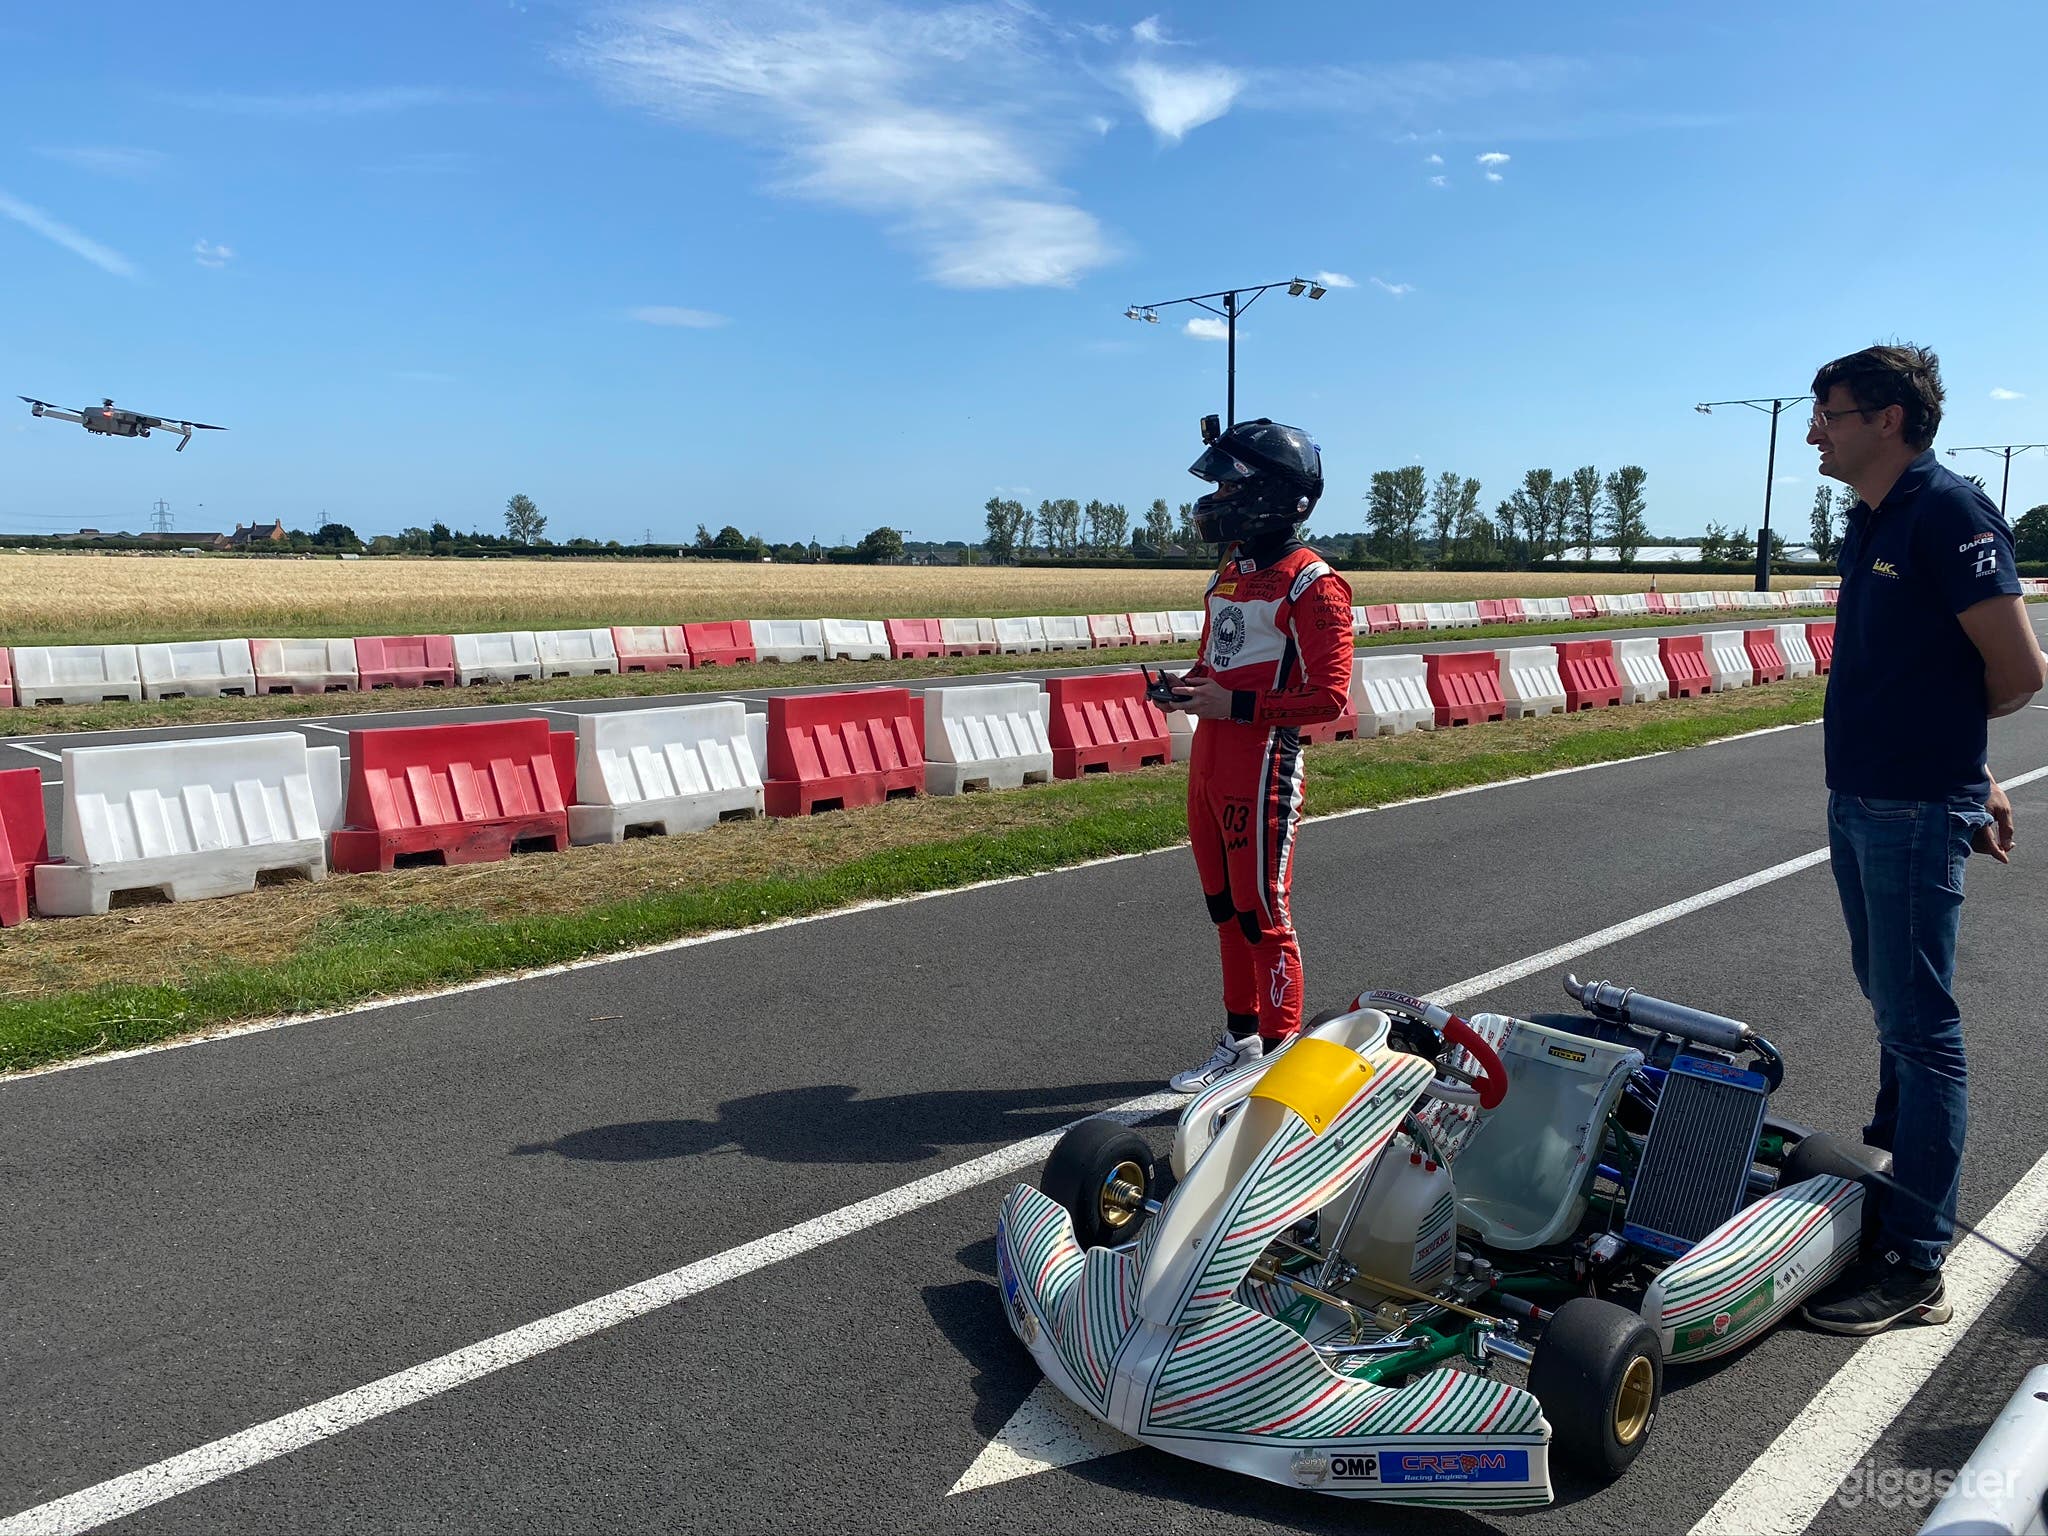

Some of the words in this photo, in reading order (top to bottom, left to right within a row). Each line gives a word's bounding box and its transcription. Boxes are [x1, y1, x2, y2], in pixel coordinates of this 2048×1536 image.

[1222, 804, 1249, 833] 03
[1331, 1458, 1377, 1476] OMP
[1404, 1474, 1433, 1482] Racing
[1435, 1472, 1468, 1481] Engines
